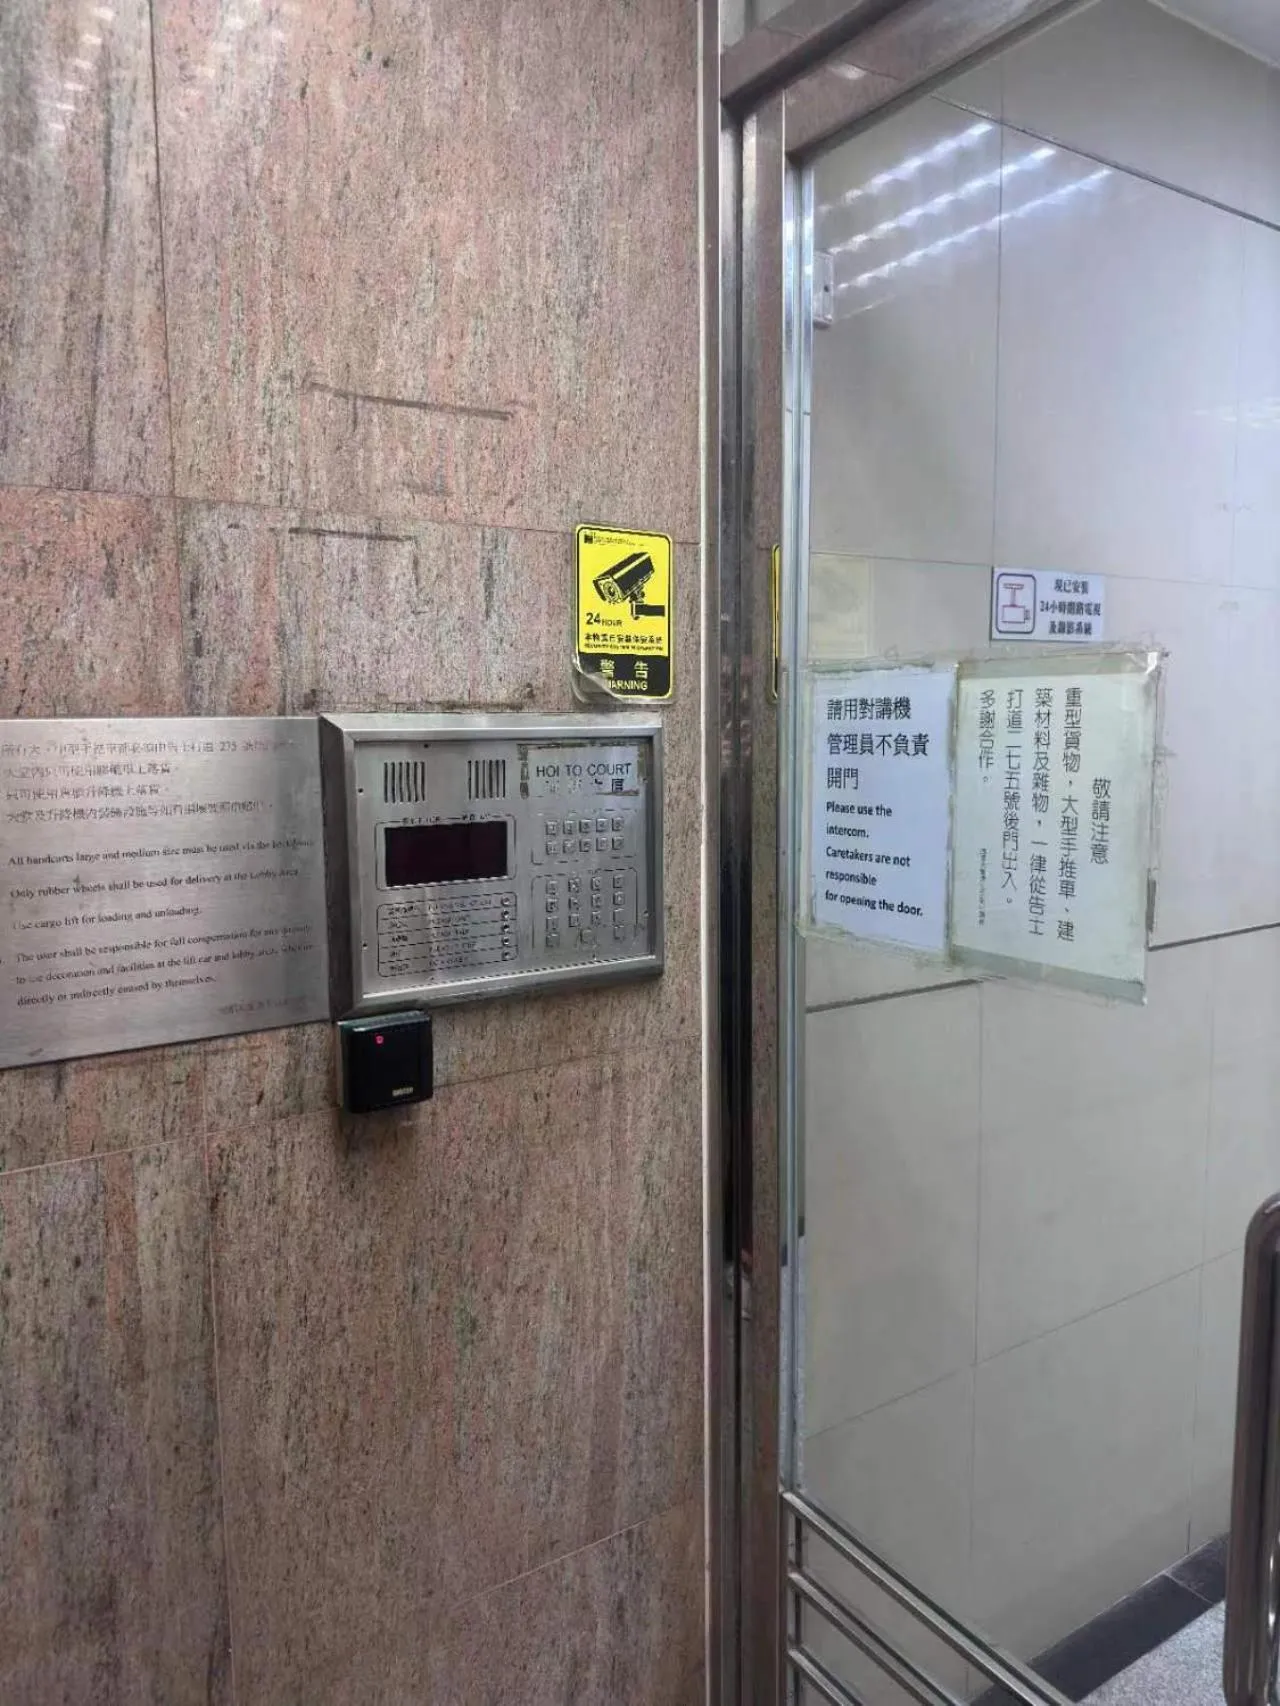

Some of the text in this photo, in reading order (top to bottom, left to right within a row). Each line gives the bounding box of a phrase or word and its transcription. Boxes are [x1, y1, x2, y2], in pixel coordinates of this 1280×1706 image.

[586, 612, 623, 627] 24 HOUR
[827, 696, 911, 720] 請用對講機
[827, 733, 929, 757] 管理員不負責
[536, 763, 632, 777] HOI TO COURT
[827, 767, 859, 790] 開門
[827, 801, 893, 817] Please use the
[827, 822, 870, 838] intercom.
[1090, 777, 1112, 865] 敬請注意
[8, 856, 25, 866] All
[26, 854, 74, 865] handcarts
[76, 852, 100, 864] large
[102, 850, 119, 860] and
[122, 847, 160, 858] medium
[256, 840, 270, 849] the
[827, 846, 911, 867] Caretakers are not
[38, 885, 69, 897] rubber
[109, 880, 130, 891] shall
[133, 879, 144, 888] be
[147, 878, 168, 887] used
[171, 876, 183, 886] for
[185, 874, 223, 886] delivery
[224, 873, 232, 882] at
[234, 872, 247, 881] the
[825, 869, 877, 886] responsible
[825, 890, 924, 916] for opening the door.
[34, 919, 62, 929] cargo
[64, 915, 79, 926] lift
[82, 915, 95, 925] for
[98, 912, 133, 923] loading
[135, 910, 152, 919] and
[60, 948, 83, 958] shall
[85, 946, 96, 956] be
[98, 941, 152, 954] responsible
[154, 939, 167, 948] for
[16, 975, 26, 985] to
[97, 965, 115, 975] and
[117, 962, 155, 974] facilities
[157, 960, 165, 969] at
[167, 958, 181, 967] the
[199, 954, 213, 963] car
[215, 951, 230, 961] and
[18, 993, 55, 1006] directly
[117, 981, 149, 993] caused
[151, 980, 163, 991] by
